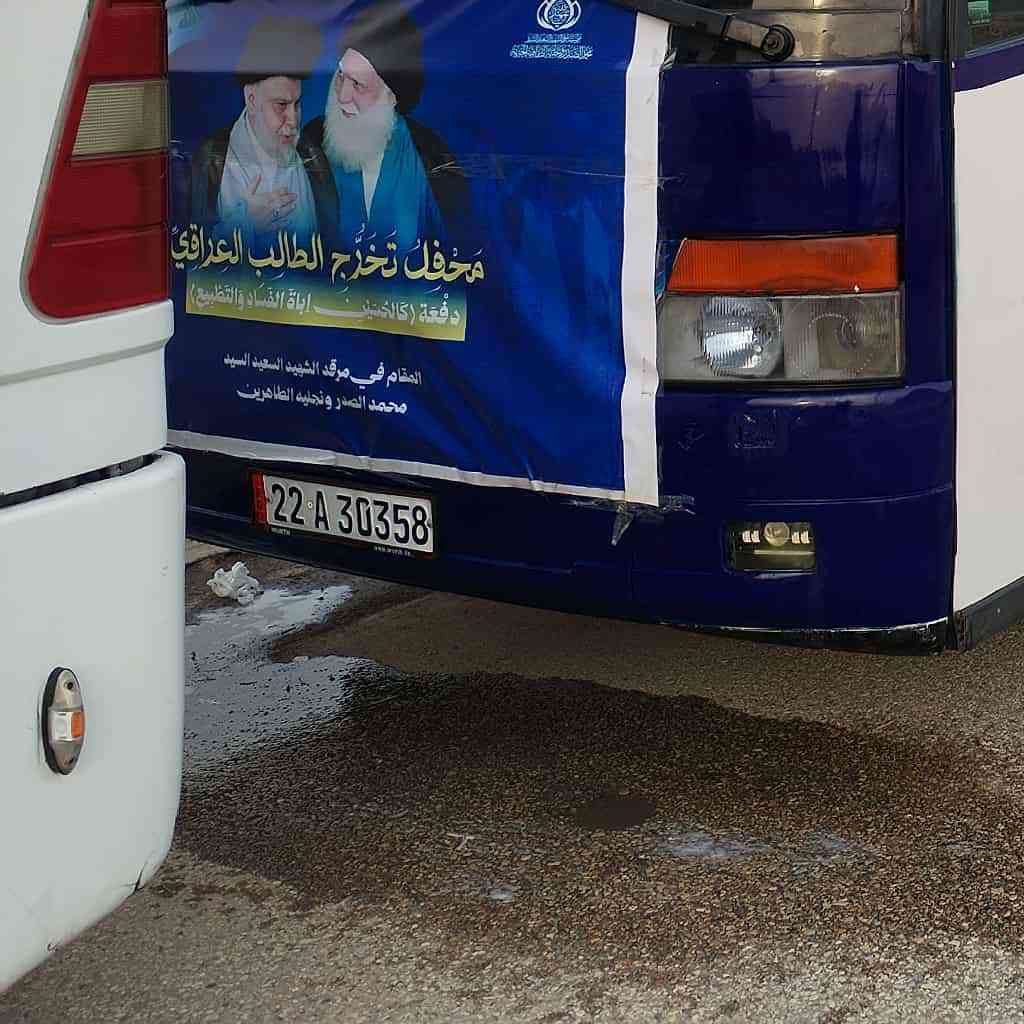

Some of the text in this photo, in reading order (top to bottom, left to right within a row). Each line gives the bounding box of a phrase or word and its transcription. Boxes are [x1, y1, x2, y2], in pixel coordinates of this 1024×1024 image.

[322, 358, 350, 383] مرقد
[350, 361, 386, 389] في
[387, 367, 423, 387] المقام
[368, 398, 408, 414] محمد
[271, 483, 430, 546] 22 A 30358
